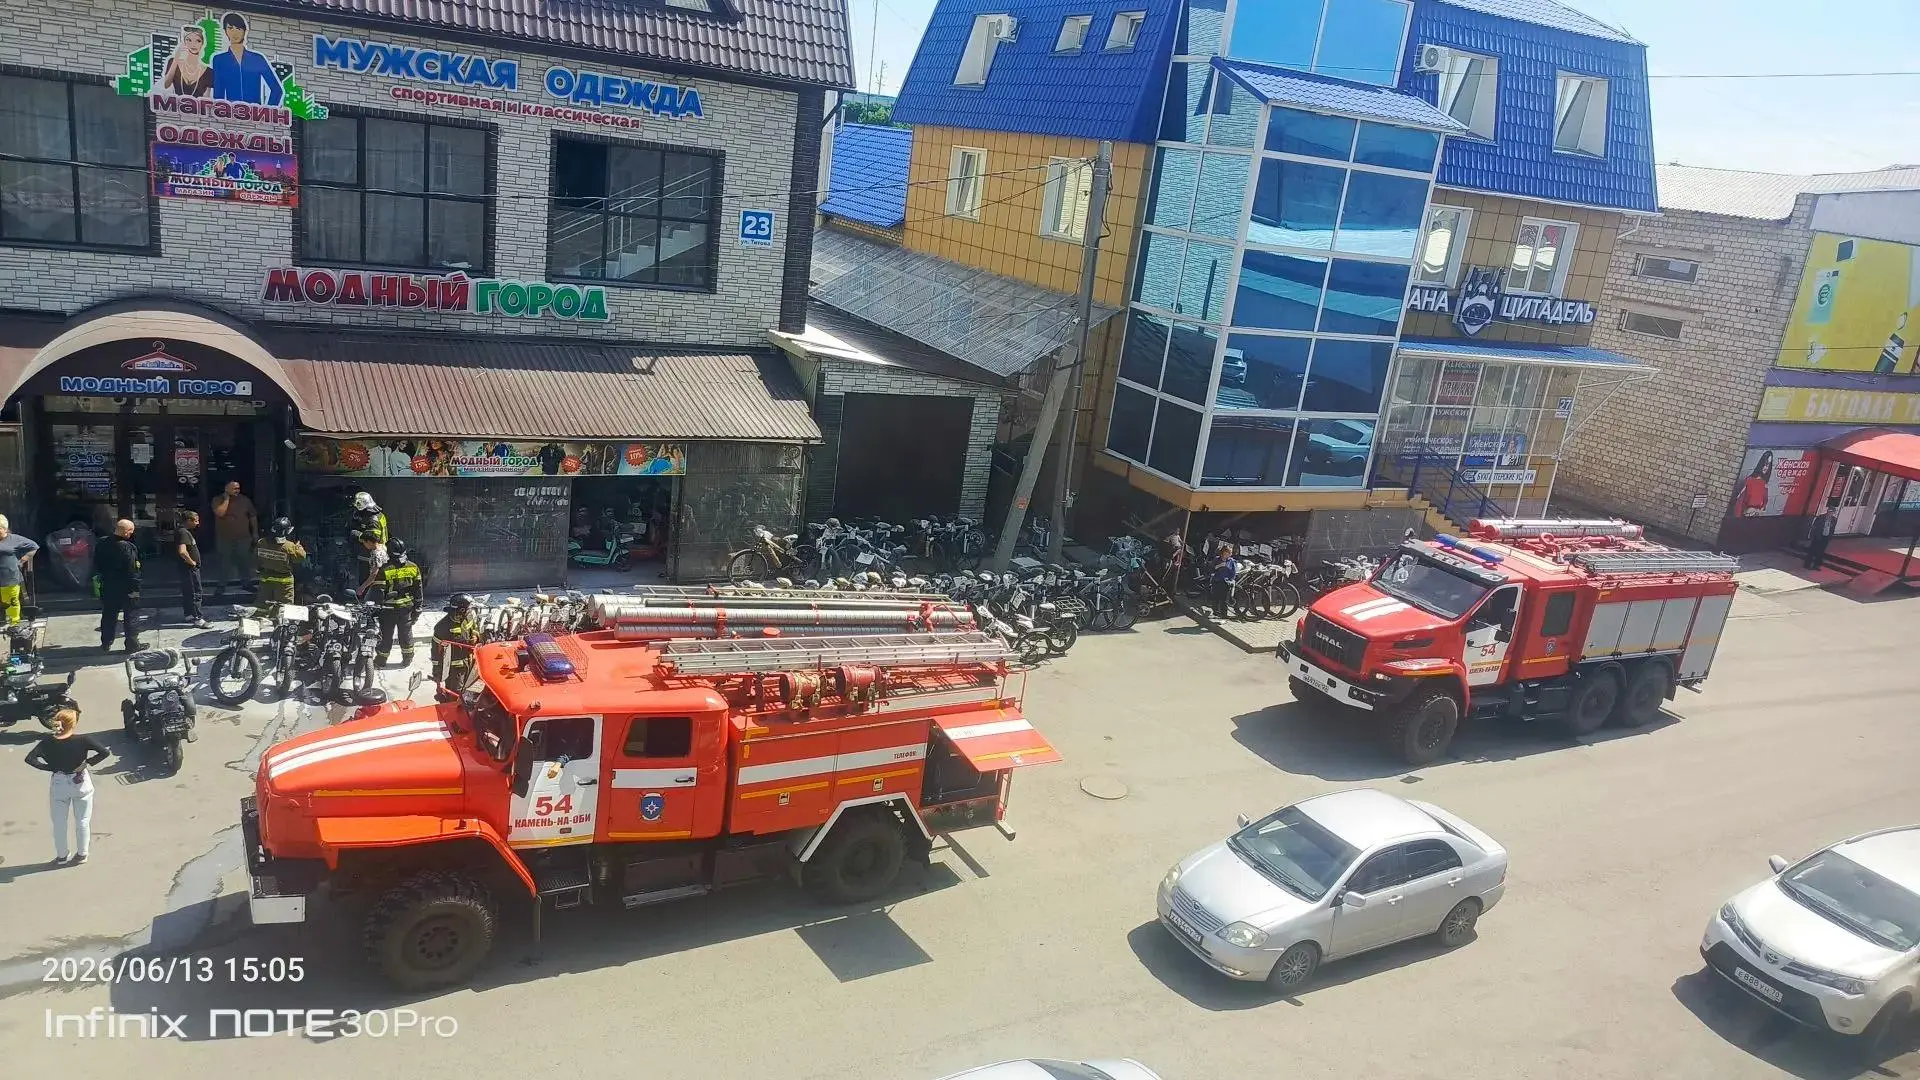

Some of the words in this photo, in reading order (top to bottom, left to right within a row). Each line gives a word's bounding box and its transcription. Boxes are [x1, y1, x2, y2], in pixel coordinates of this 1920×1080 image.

[314, 35, 518, 91] МУЖСКАЯ
[544, 66, 704, 118] ОДЕЖДА
[152, 94, 291, 126] магазин
[391, 86, 501, 112] спортивная
[522, 103, 640, 129] классическая
[159, 126, 292, 154] одежды
[744, 215, 770, 235] 23
[263, 268, 470, 311] МОДНЫЙ
[476, 280, 609, 319] ГОРОД
[1502, 296, 1594, 325] ЦИТАДЕЛЬ
[61, 375, 169, 393] МОДНЫЙ
[179, 379, 252, 395] ГОРОД
[1559, 399, 1573, 410] 27
[451, 456, 501, 466] МОДНЫЙ
[502, 456, 537, 466] ГОРОД
[1314, 631, 1343, 649] URAL
[1480, 645, 1496, 657] 54
[535, 794, 573, 816] 54
[515, 813, 591, 828] КАМЕНЬ-НА-ОБИ
